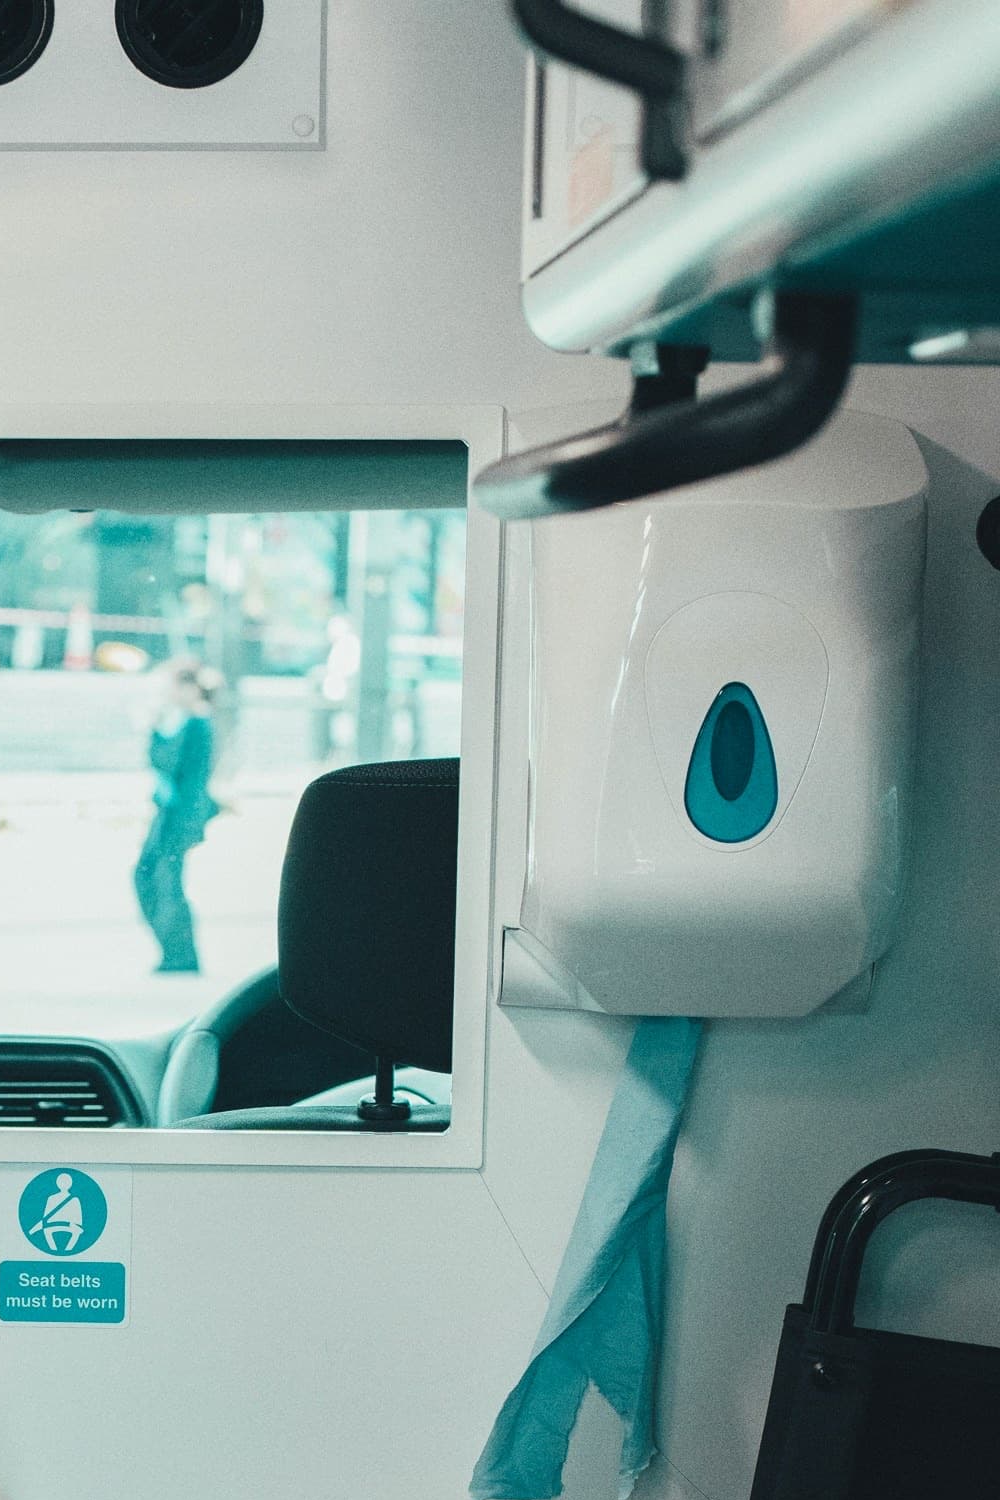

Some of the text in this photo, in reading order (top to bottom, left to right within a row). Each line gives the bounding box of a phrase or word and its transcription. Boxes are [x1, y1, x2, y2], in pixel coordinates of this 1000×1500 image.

[18, 1272, 101, 1288] Seat belts
[6, 1294, 118, 1309] must be worn
